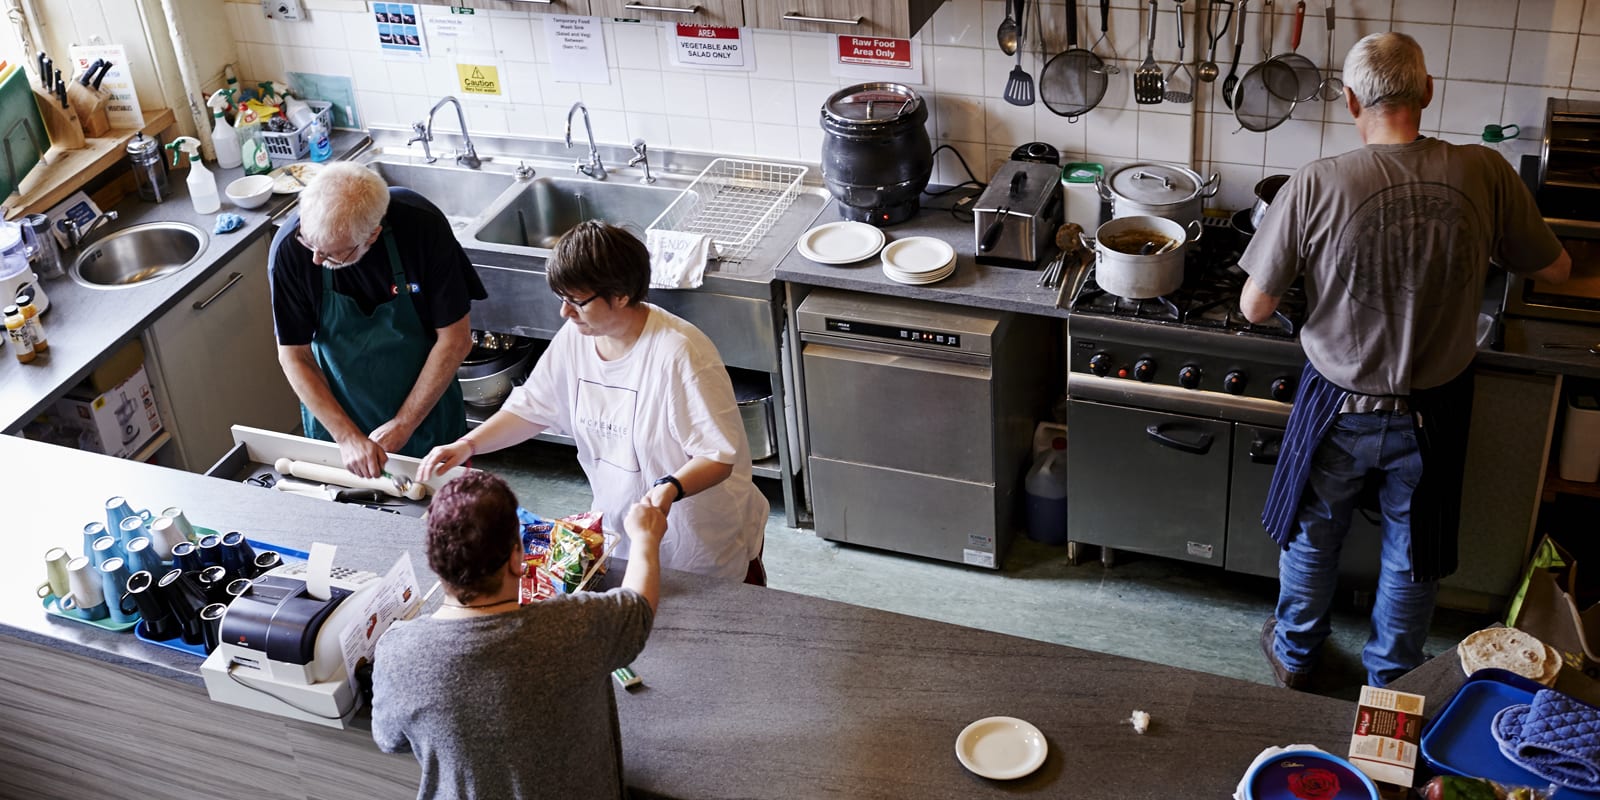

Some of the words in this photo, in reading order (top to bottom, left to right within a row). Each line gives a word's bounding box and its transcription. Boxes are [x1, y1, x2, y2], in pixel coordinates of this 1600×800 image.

[698, 29, 716, 37] AREA
[681, 42, 721, 51] VEGETABLE
[852, 38, 871, 47] Raw
[874, 39, 896, 48] Food
[688, 50, 711, 58] SALAD
[853, 47, 874, 56] Area
[875, 49, 896, 59] Only
[464, 78, 495, 87] Caution
